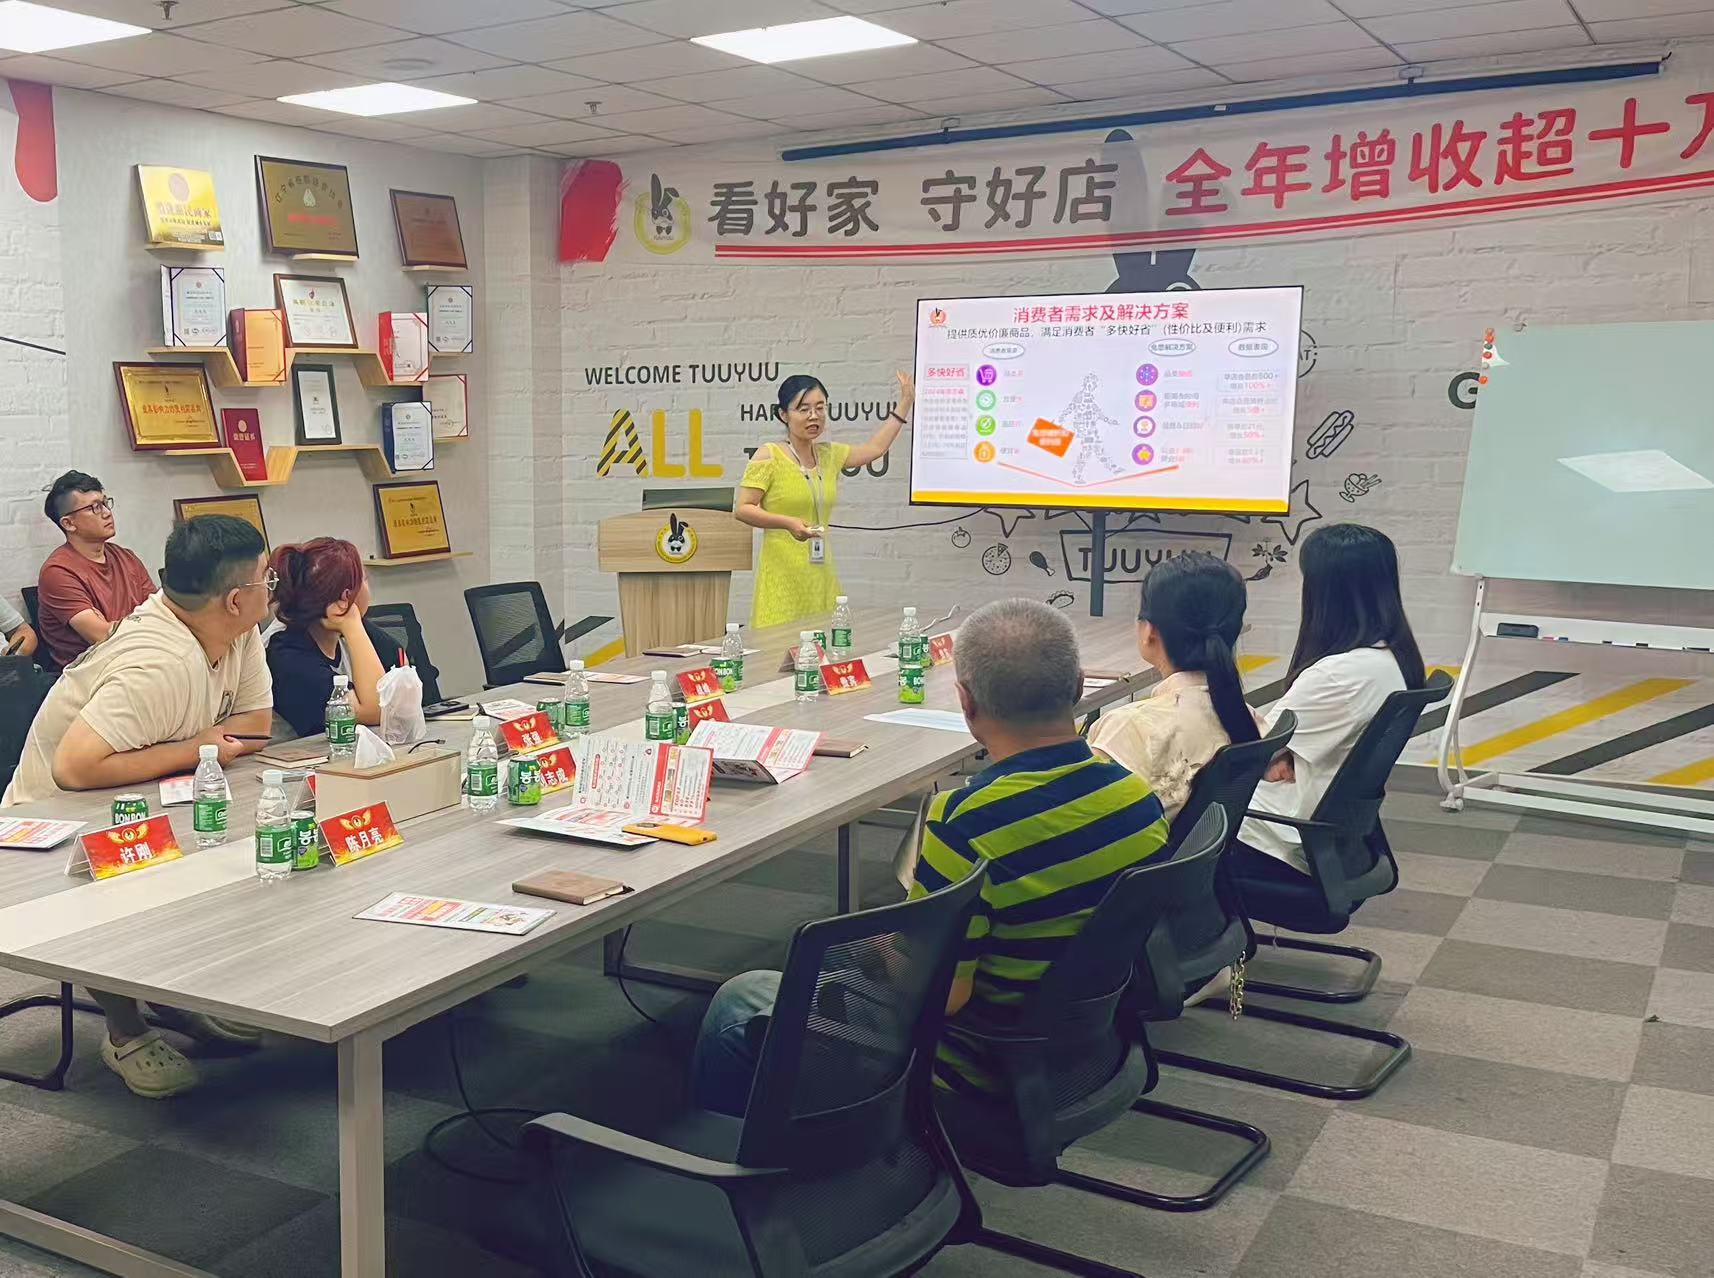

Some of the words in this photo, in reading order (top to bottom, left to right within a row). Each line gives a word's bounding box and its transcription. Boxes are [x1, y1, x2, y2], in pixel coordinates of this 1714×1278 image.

[709, 175, 880, 238] 看好家
[921, 158, 1119, 233] 守好店
[1013, 303, 1190, 323] 消费者需求及解决方案
[585, 364, 681, 385] WELCOME
[689, 361, 780, 384] TUUYUU
[927, 366, 966, 378] 多快好省
[596, 407, 725, 479] ALL
[345, 826, 384, 854] 陈月亮
[120, 841, 153, 864] 许刚
